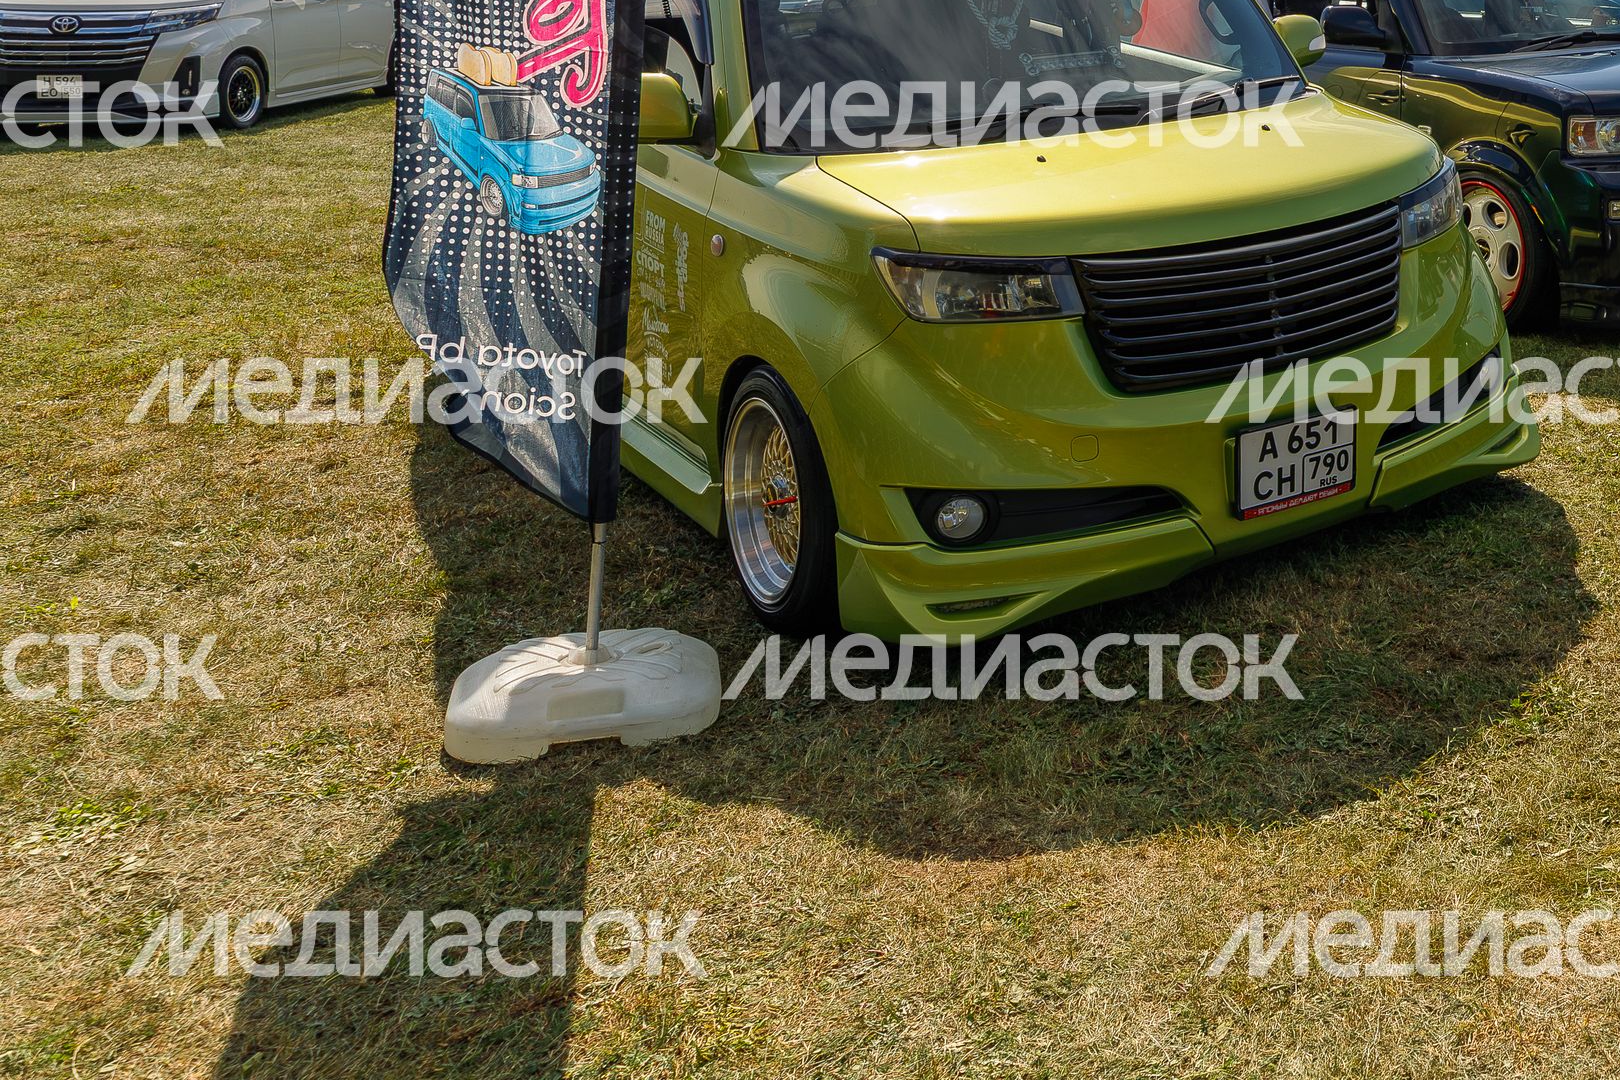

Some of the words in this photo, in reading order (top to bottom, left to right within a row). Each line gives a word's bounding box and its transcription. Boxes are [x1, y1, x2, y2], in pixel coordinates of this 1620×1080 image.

[646, 210, 666, 233] FROM
[1258, 431, 1278, 462] А
[1287, 416, 1338, 454] 651
[1253, 464, 1295, 500] СН
[1309, 449, 1349, 480] 790
[1320, 475, 1338, 487] RUS
